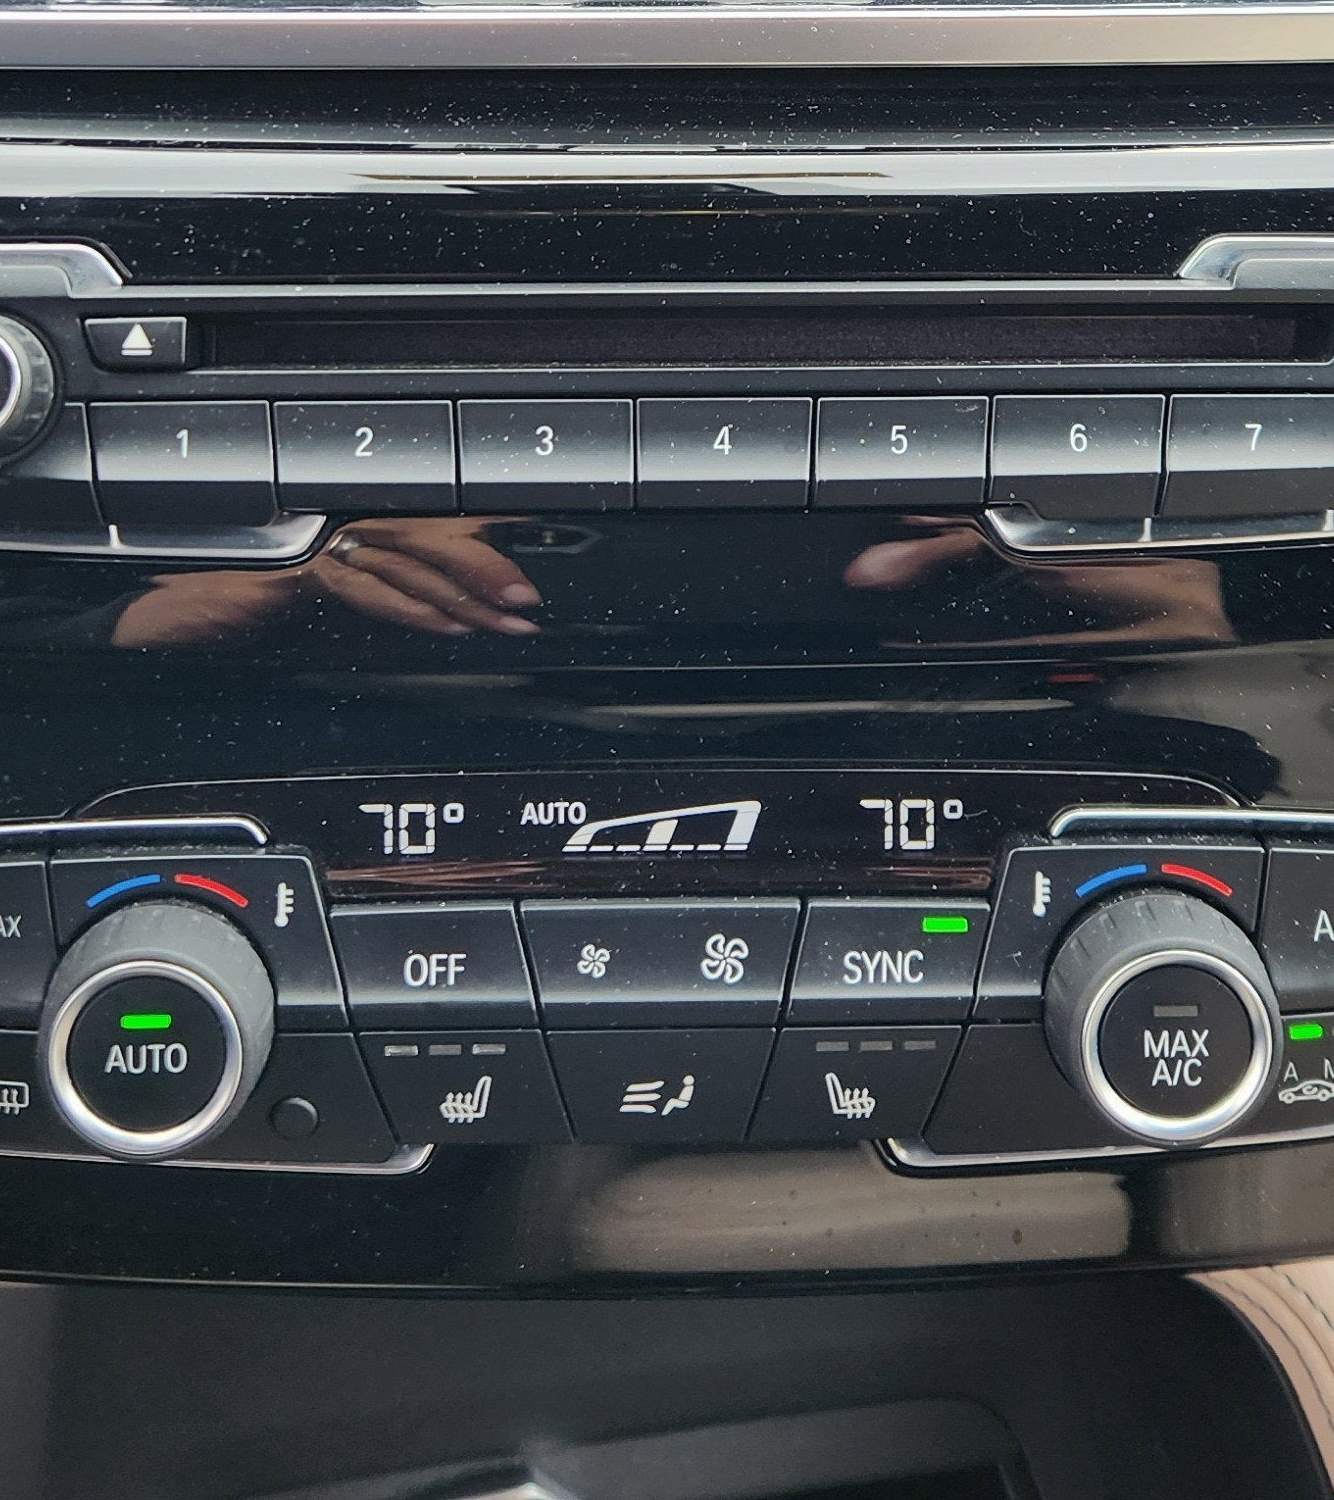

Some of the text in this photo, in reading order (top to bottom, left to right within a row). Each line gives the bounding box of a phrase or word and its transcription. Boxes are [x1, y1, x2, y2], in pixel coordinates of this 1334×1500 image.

[175, 428, 189, 458] 1
[354, 427, 375, 458] 2
[535, 425, 555, 457] 3
[712, 424, 733, 456] 4
[890, 424, 909, 456] 5
[1069, 423, 1089, 454] 6
[1244, 422, 1263, 452] 7
[521, 802, 588, 826] AUTO
[403, 953, 465, 987] OFF
[843, 950, 924, 985] SYNC
[105, 1043, 188, 1074] AUTO
[1144, 1029, 1210, 1059] MAX
[1151, 1058, 1202, 1088] A/C
[1283, 1061, 1299, 1082] A
